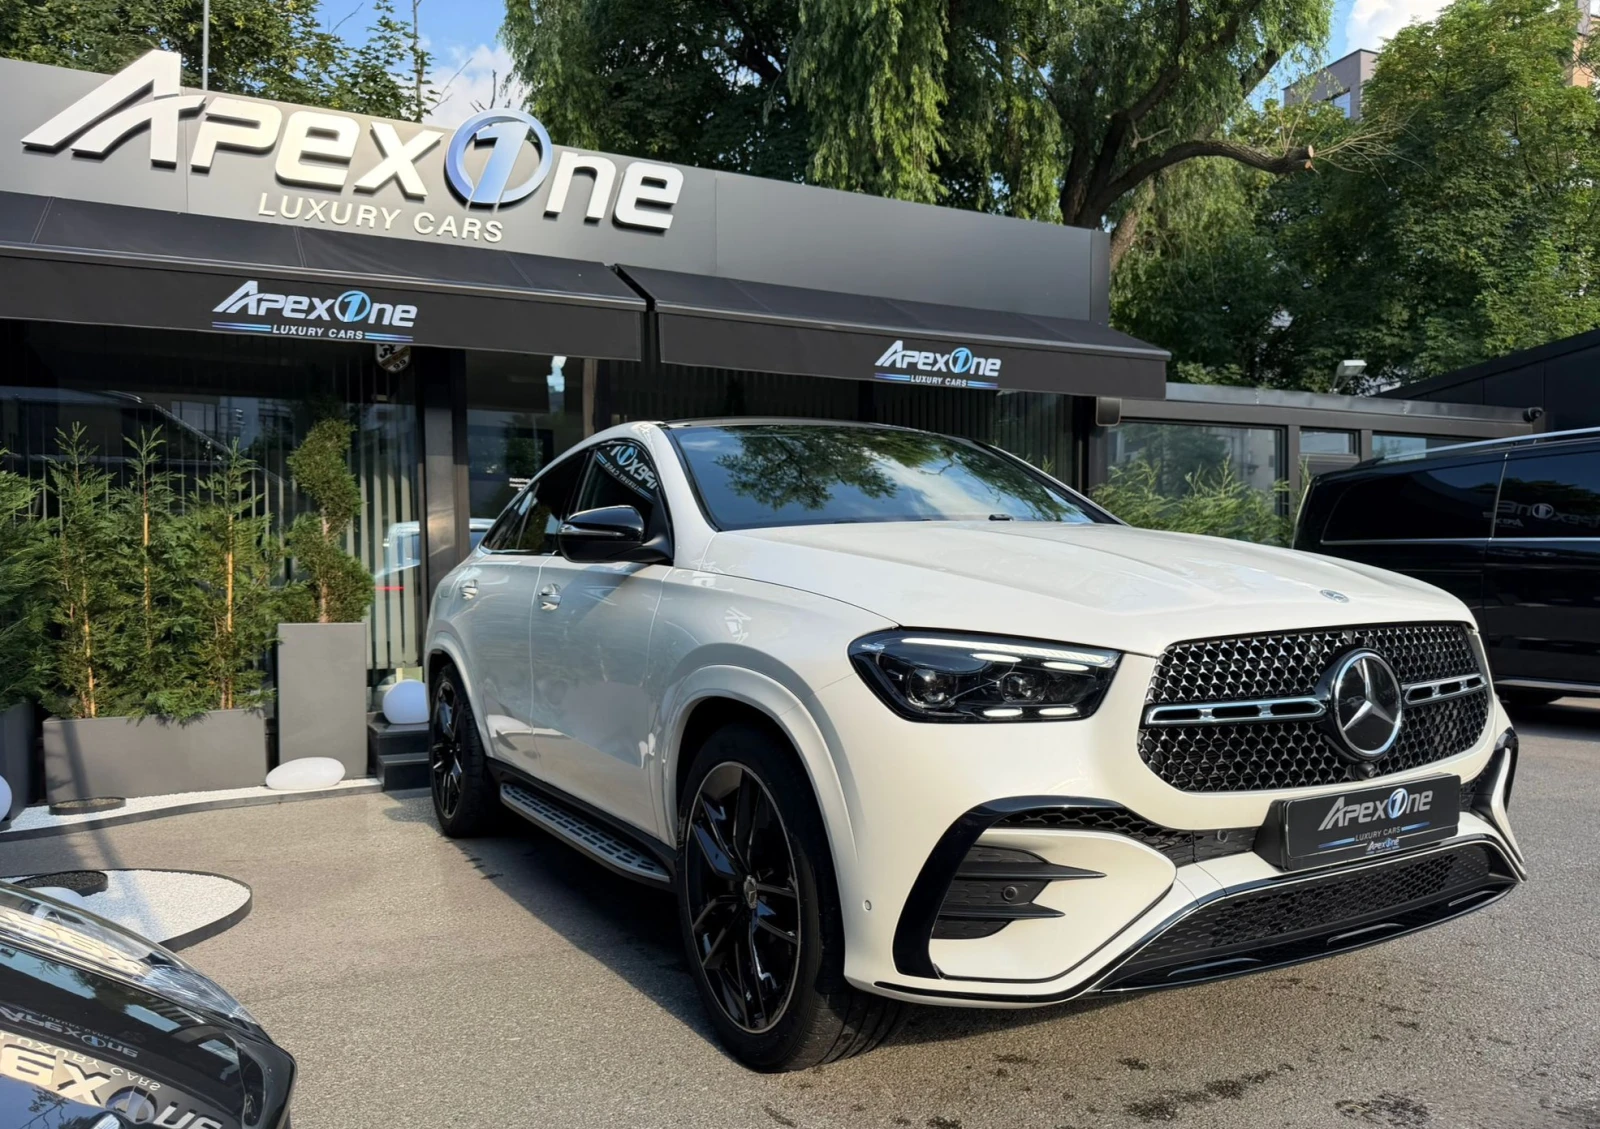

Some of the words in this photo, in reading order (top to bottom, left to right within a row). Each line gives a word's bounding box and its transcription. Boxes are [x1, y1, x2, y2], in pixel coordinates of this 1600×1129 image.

[257, 191, 402, 231] LUXURY
[413, 210, 504, 244] CARS
[272, 324, 325, 337] LUXURY
[328, 329, 364, 340] CARS
[910, 375, 943, 385] LUXURY
[945, 378, 967, 387] CARS
[1355, 830, 1382, 842] LUXURY
[1383, 826, 1401, 836] CARS
